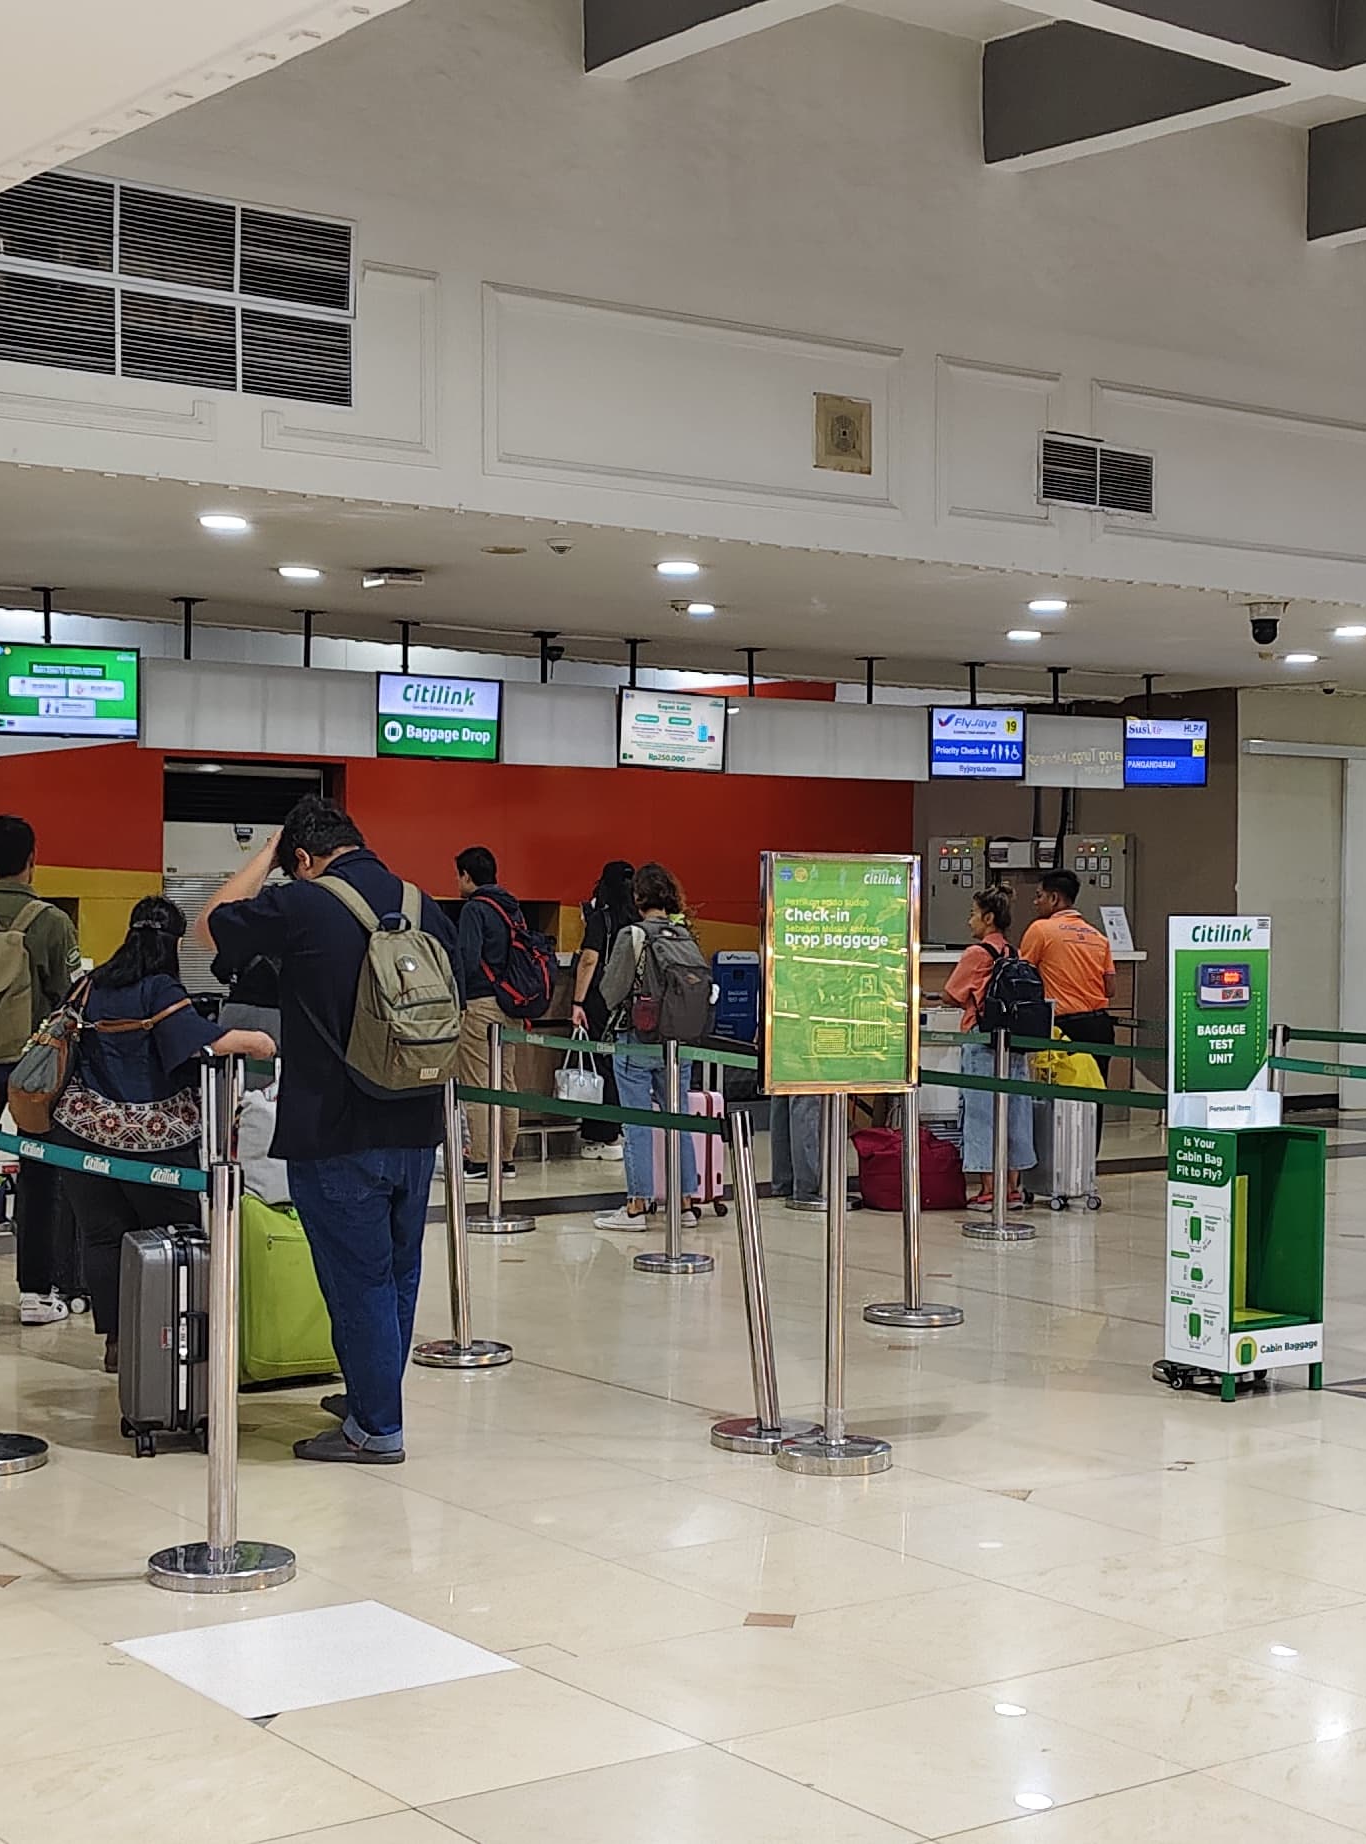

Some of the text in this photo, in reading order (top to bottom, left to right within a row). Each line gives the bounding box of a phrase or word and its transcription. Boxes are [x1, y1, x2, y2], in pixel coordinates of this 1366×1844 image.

[402, 684, 476, 706] Citilink
[1006, 720, 1017, 733] 19
[1128, 724, 1150, 735] Susi
[406, 724, 491, 745] Baggage Drop
[935, 746, 989, 756] Priority Check-in
[863, 873, 902, 885] Citilink
[784, 907, 850, 922] Check-in
[1191, 924, 1253, 943] Citilink
[784, 933, 889, 949] Drop Baggage
[1196, 1024, 1247, 1036] BAGGAGE
[1209, 1039, 1234, 1050] TEST
[1208, 1053, 1234, 1064] UNIT
[1183, 1135, 1216, 1149] Is Your
[1176, 1149, 1223, 1167] Cabin Bag
[83, 1155, 111, 1174] Citilink
[150, 1167, 180, 1185] Citilink
[1176, 1164, 1223, 1181] Fit to Fly?
[1260, 1340, 1318, 1354] Cabin Baggage
